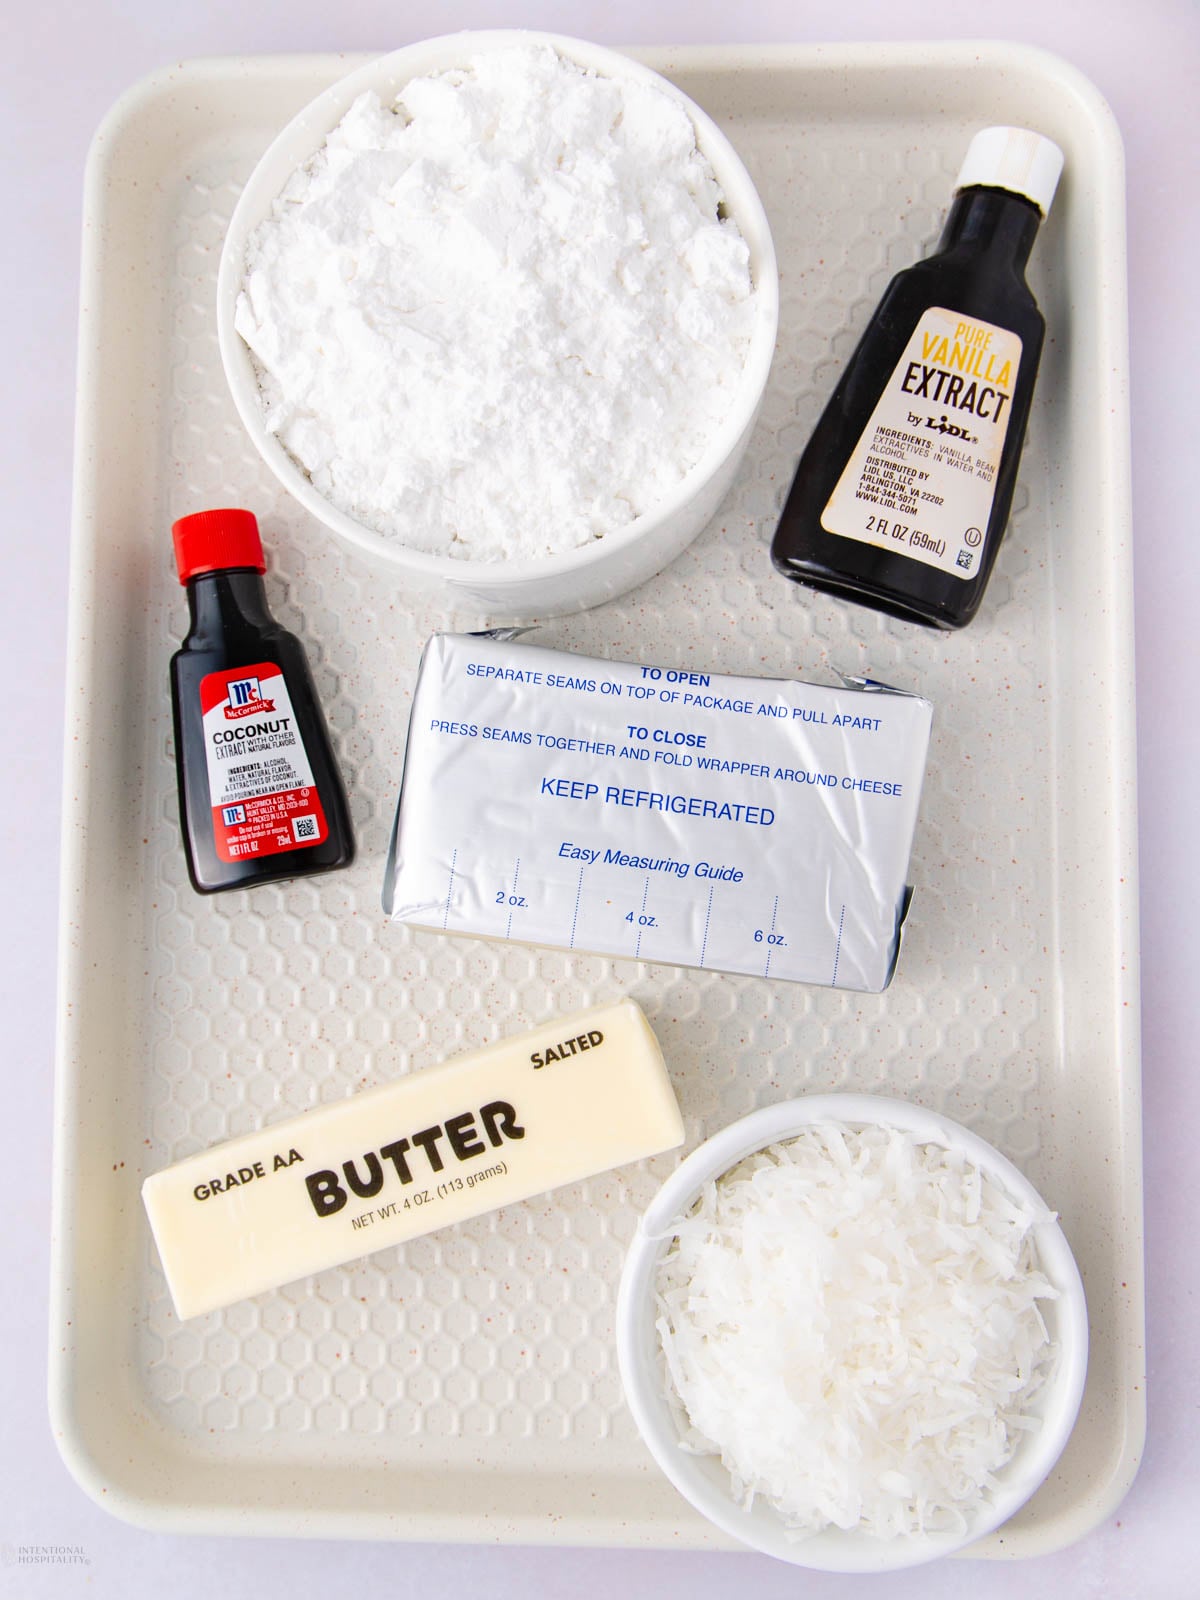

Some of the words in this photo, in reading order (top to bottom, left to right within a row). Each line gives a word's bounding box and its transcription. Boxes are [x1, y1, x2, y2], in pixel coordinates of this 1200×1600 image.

[954, 322, 993, 350] PURE
[922, 332, 1011, 388] VANILLA
[901, 362, 1009, 424] EXTRACT
[907, 412, 922, 426] by
[873, 435, 929, 458] EXTRACTIVES
[934, 452, 942, 462] IN
[946, 458, 974, 474] WATER
[977, 470, 992, 482] AND
[876, 426, 934, 450] INGREDIENTS:
[940, 445, 972, 464] VANILLA
[976, 459, 996, 474] BEAN
[864, 464, 880, 476] LIDL
[898, 474, 914, 486] LLC
[866, 456, 916, 476] DISTRIBUTED
[918, 472, 930, 480] BY
[855, 490, 918, 516] WWW.LIDL.COM
[858, 482, 916, 505] 1-844-344-5071
[910, 488, 920, 498] VA
[921, 492, 944, 506] 22202
[866, 516, 876, 530] 2
[876, 518, 888, 536] FL
[892, 524, 908, 541] OZ
[909, 530, 946, 558] (59mL)
[640, 666, 662, 680] TO
[666, 670, 710, 686] OPEN
[226, 700, 269, 718] McCormick
[466, 664, 542, 684] SEPARATE
[546, 674, 596, 692] SEAMS
[600, 682, 622, 696] ON
[626, 685, 656, 700] TOP
[660, 690, 680, 704] OF
[684, 693, 753, 714] PACKAGE
[757, 704, 788, 718] AND
[792, 708, 828, 724] PULL
[832, 714, 882, 731] APART
[213, 718, 290, 744] COCONUT
[247, 737, 266, 746] WITH
[268, 732, 294, 742] OTHER
[627, 726, 648, 740] TO
[653, 730, 706, 748] CLOSE
[216, 742, 246, 760] EXTRACT
[248, 744, 272, 753] NATURAL
[272, 738, 296, 748] FLAVORS
[430, 720, 478, 736] PRESS
[482, 727, 532, 744] SEAMS
[536, 734, 616, 756] TOGETHER
[620, 747, 650, 761] AND
[654, 752, 692, 767] FOLD
[697, 757, 770, 778] WRAPPER
[774, 768, 838, 787] AROUND
[842, 777, 902, 796] CHEESE
[248, 768, 271, 778] NATURAL
[272, 764, 291, 774] FLAVOR
[230, 777, 264, 791] EXTRACTIVES
[256, 787, 268, 796] NEAR
[276, 783, 288, 792] OPEN
[541, 777, 598, 800] KEEP
[606, 786, 775, 826] REFRIGERATED
[228, 844, 240, 856] NET
[240, 844, 244, 854] 1
[244, 842, 251, 853] FL
[252, 840, 259, 851] OZ
[558, 842, 600, 865] Easy
[604, 849, 690, 878] Measuring
[694, 862, 744, 883] Guide
[495, 891, 505, 904] 2
[508, 896, 529, 908] oz.
[625, 911, 634, 924] 4
[638, 916, 659, 928] oz.
[754, 930, 763, 942] 6
[767, 934, 788, 946] oz.
[530, 1030, 605, 1070] SALTED
[304, 1100, 525, 1218] BUTTER
[193, 1162, 266, 1202] GRADE
[272, 1148, 304, 1172] AA
[351, 1212, 376, 1230] NET
[379, 1204, 400, 1222] WT.
[403, 1198, 412, 1210] 4
[413, 1192, 434, 1207] OZ.
[437, 1181, 464, 1201] (113
[466, 1161, 508, 1191] grams)
